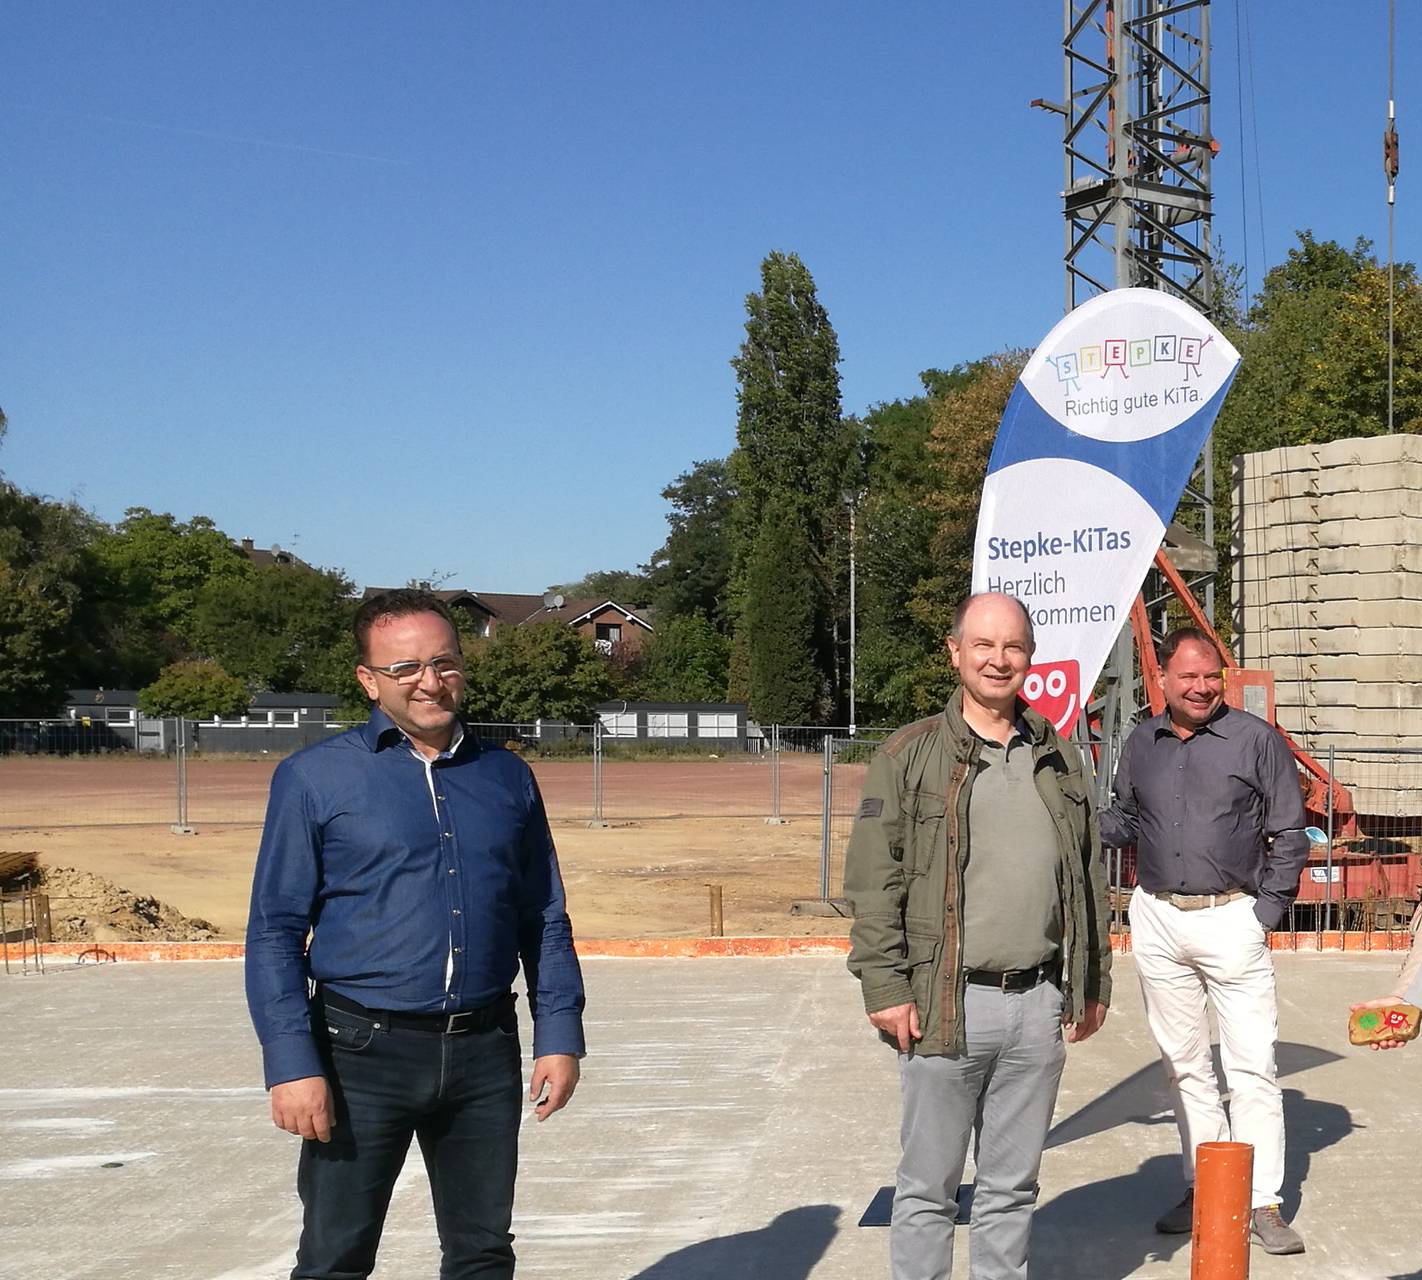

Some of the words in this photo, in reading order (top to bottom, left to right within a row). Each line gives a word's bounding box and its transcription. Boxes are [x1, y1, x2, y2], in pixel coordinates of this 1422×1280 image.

[1063, 341, 1195, 375] STEPKE
[1065, 396, 1119, 417] Richtig
[1123, 391, 1159, 415] gute
[1164, 385, 1204, 406] KiTa.
[988, 527, 1132, 564] Stepke-KiTas
[988, 570, 1066, 597] Herzlich
[1026, 603, 1115, 627] kommen
